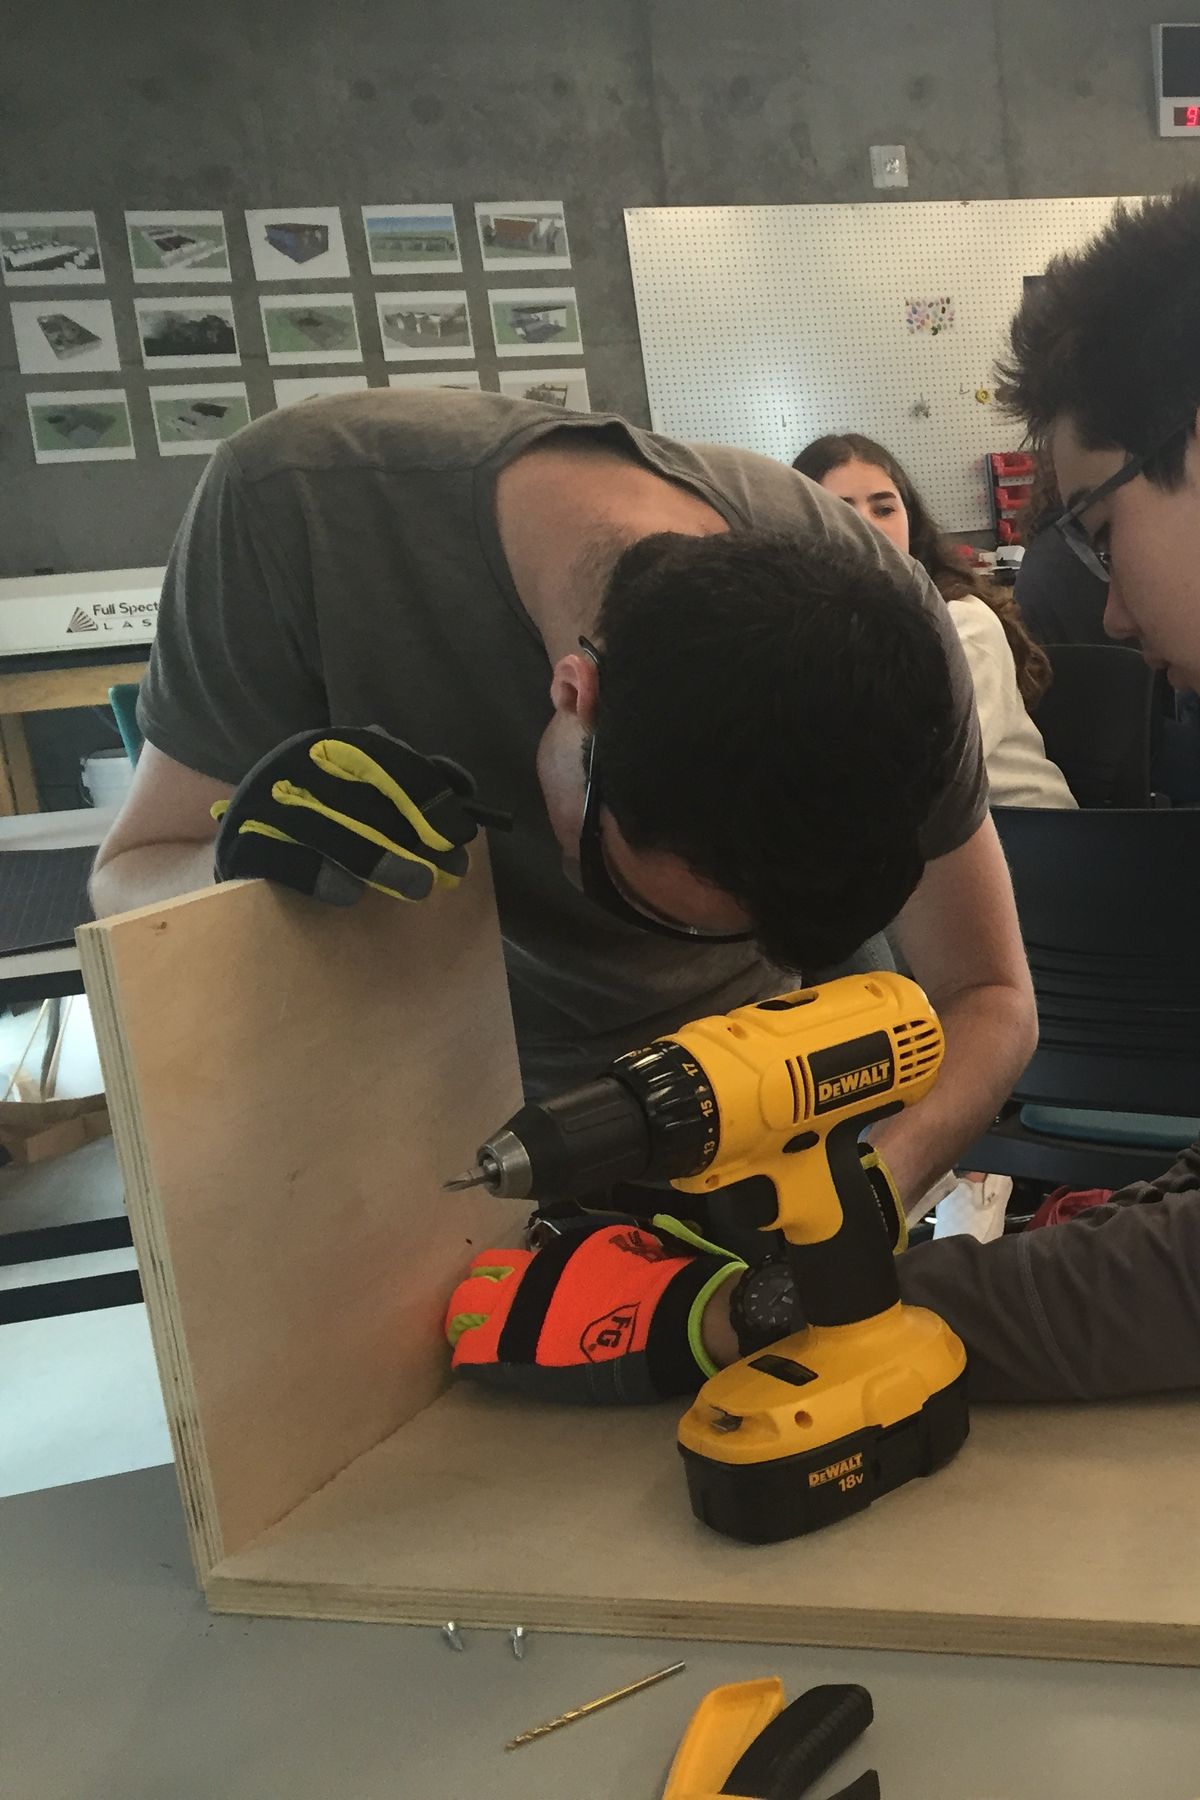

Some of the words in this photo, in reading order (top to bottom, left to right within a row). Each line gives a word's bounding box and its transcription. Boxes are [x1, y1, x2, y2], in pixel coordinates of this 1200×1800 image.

[93, 604, 116, 616] Full
[682, 1062, 699, 1077] 17
[700, 1099, 714, 1118] 15
[703, 1140, 716, 1155] 13
